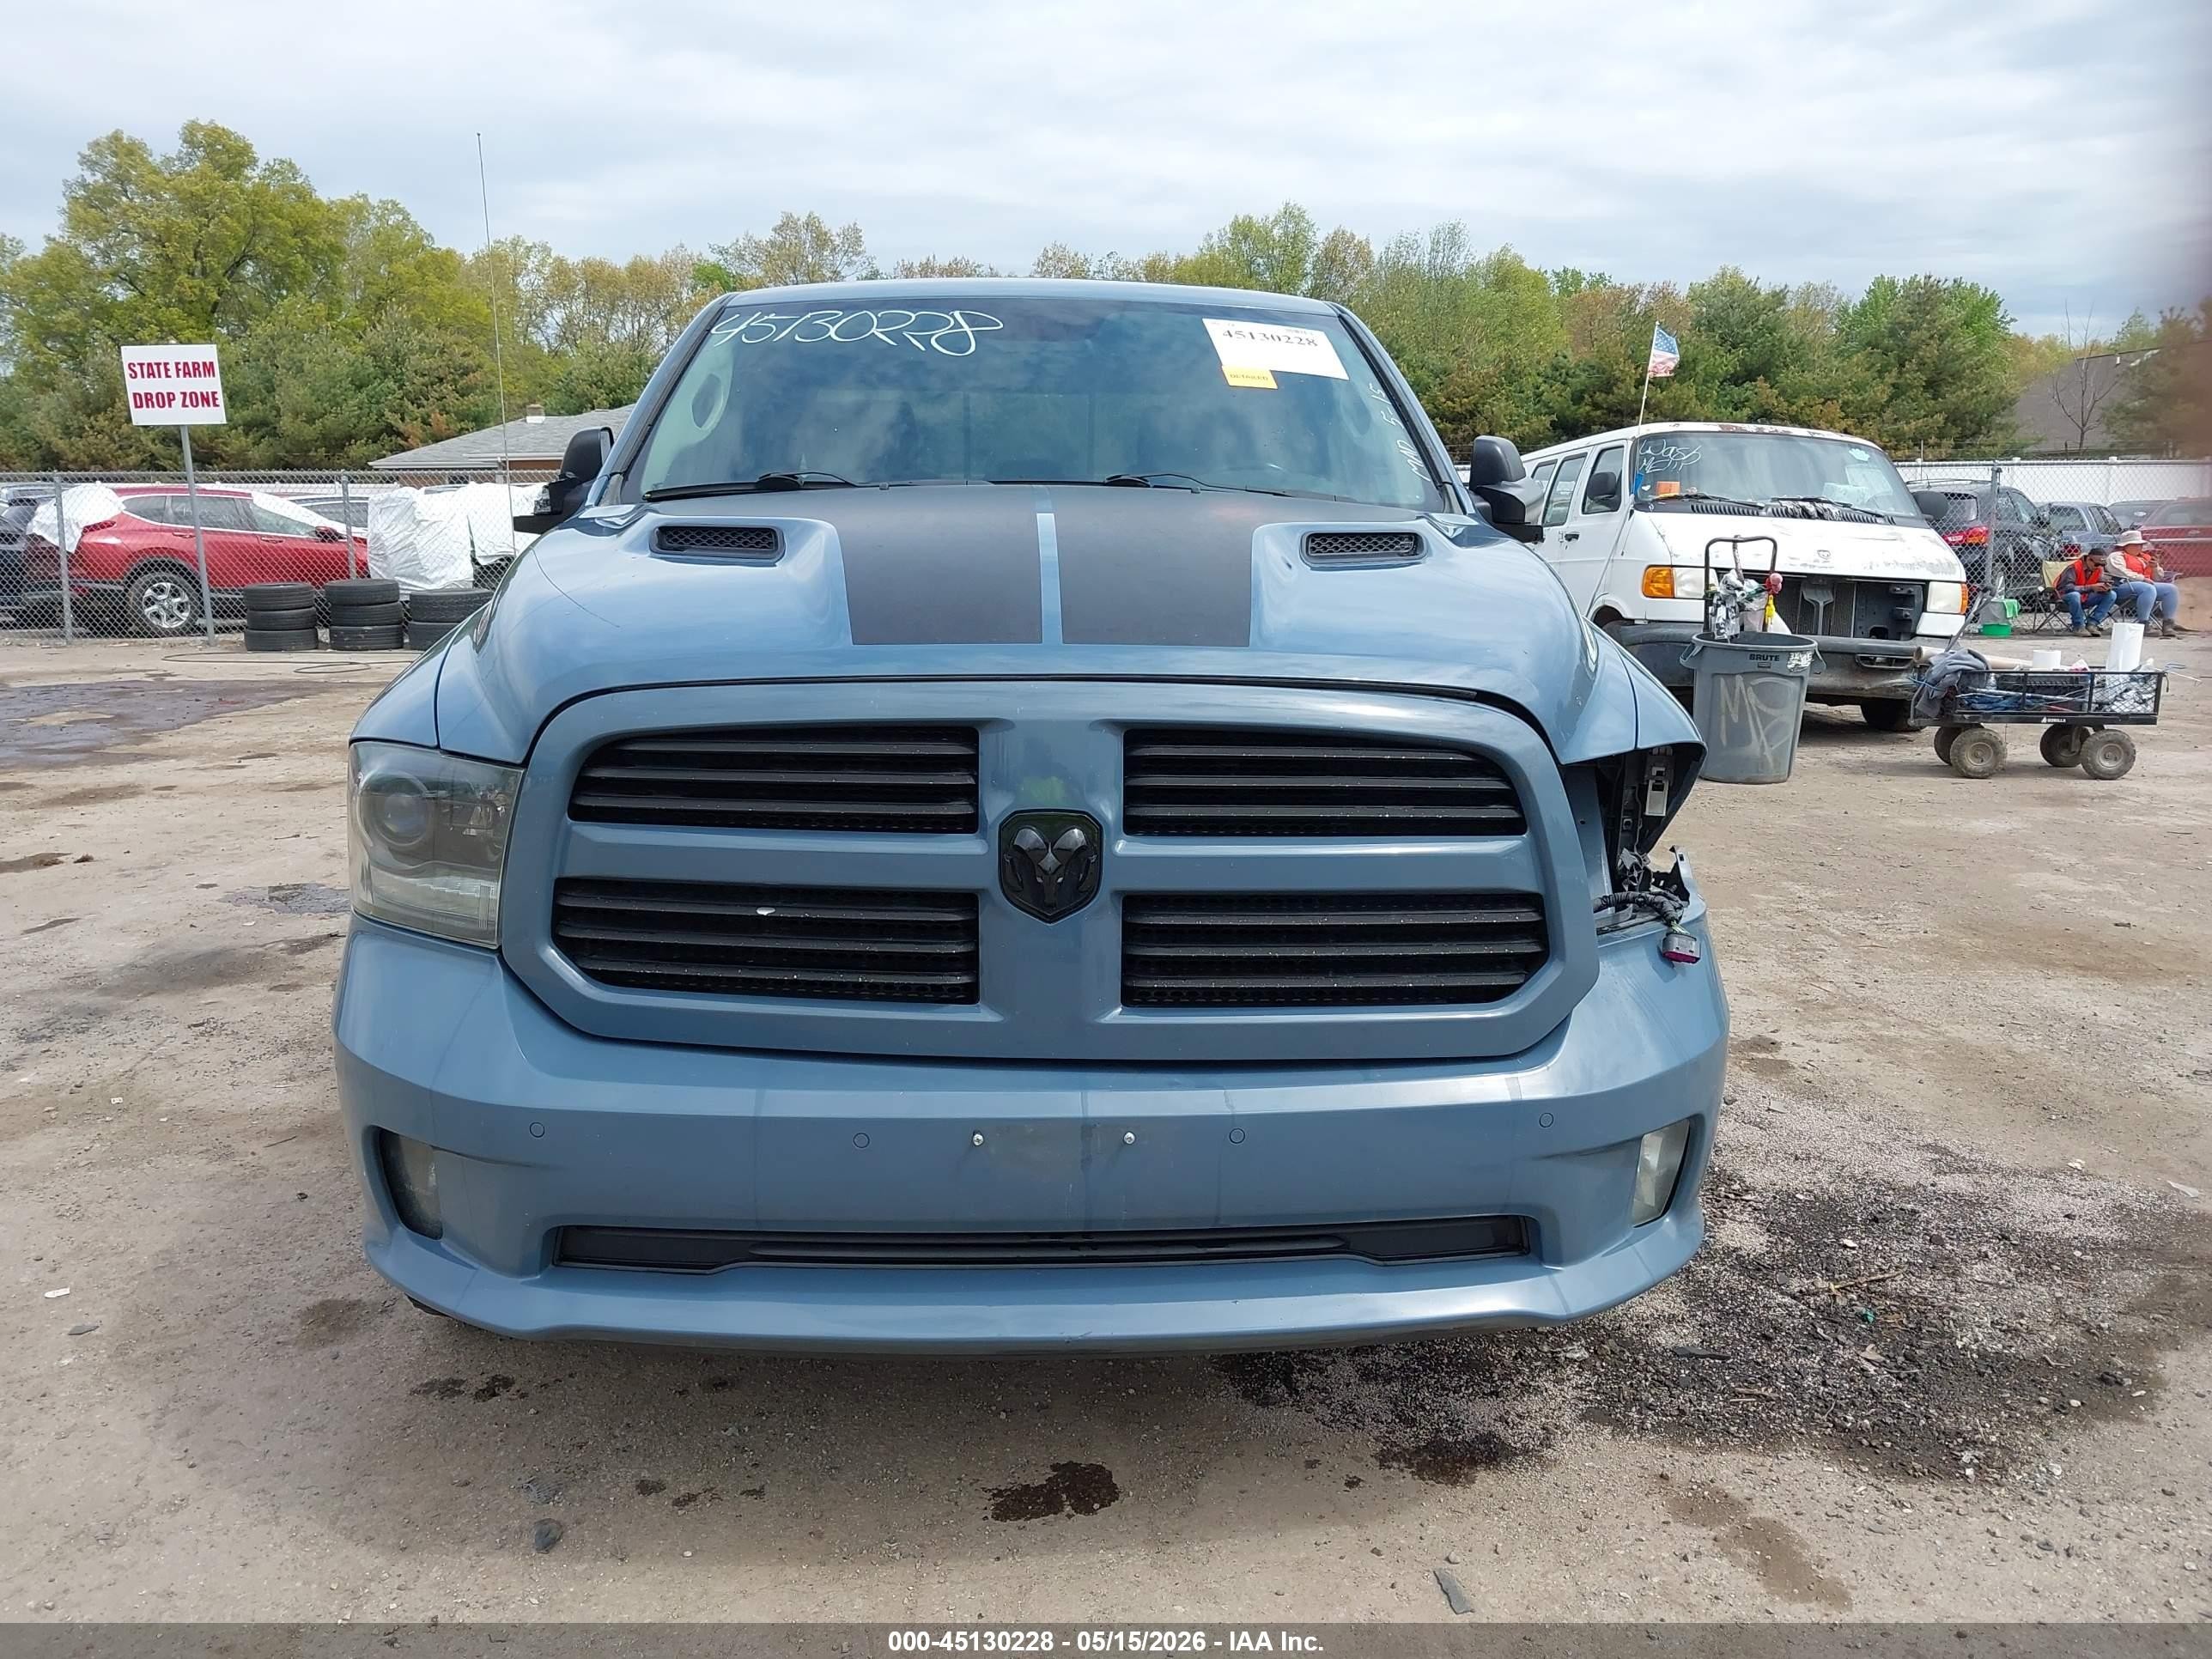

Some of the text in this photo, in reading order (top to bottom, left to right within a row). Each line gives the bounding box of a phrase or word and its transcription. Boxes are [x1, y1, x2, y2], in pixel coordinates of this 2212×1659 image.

[710, 310, 1004, 356] 45130228
[1222, 329, 1319, 347] 45130228
[127, 361, 216, 379] STATE FARM
[132, 391, 221, 409] DROP ZONE
[1748, 653, 1780, 662] BRUTE
